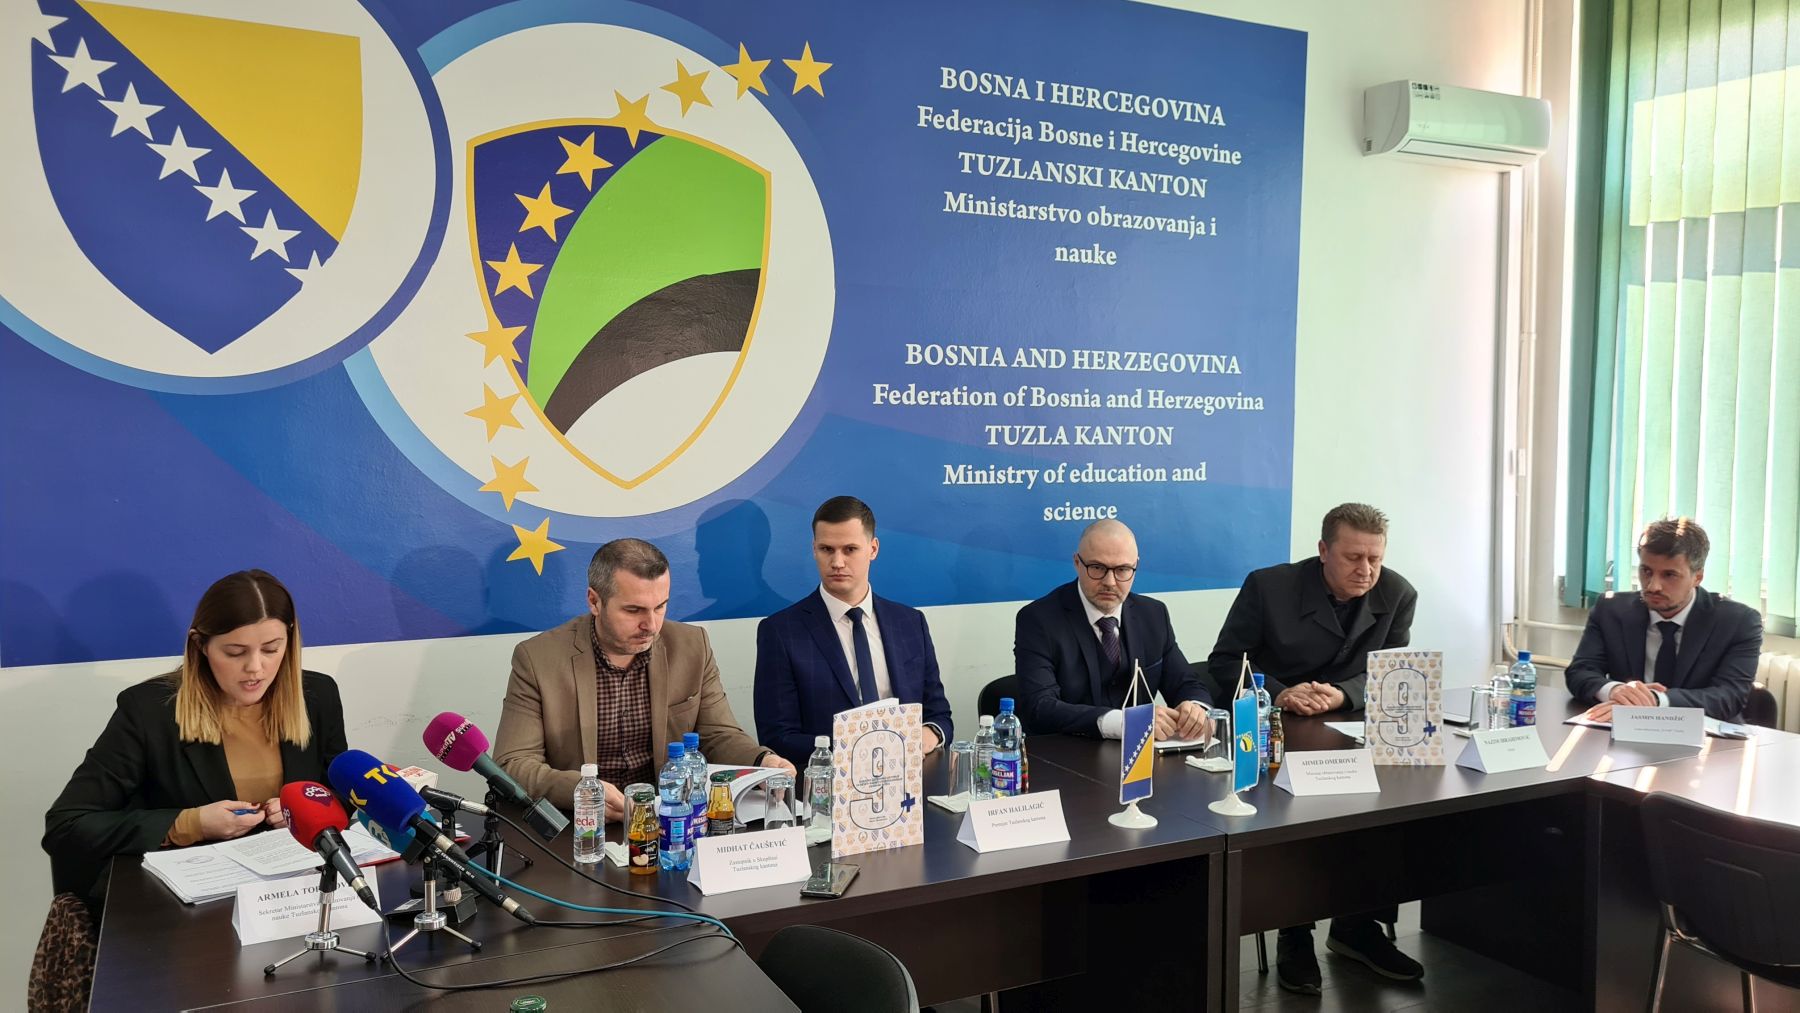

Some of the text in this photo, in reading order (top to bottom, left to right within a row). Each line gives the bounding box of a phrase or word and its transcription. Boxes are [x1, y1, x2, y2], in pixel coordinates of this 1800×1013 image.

[940, 66, 1226, 126] BOSNA I HERCEGOVINA
[917, 105, 1242, 166] Federacija Bosne i Hercegovine
[958, 151, 1208, 198] TUZLANSKI KANTON
[942, 191, 1217, 241] Ministarstvo obrazovanja i
[1054, 243, 1117, 266] nauke
[905, 343, 1242, 375] BOSNIA AND HERZEGOVINA
[872, 383, 1265, 416] Federation of Bosnia and Herzegovina
[984, 425, 1175, 446] TUZLA KANTON
[942, 461, 1208, 490] Ministry of education and
[1043, 501, 1118, 521] science
[988, 808, 1007, 817] IRFAN
[716, 838, 788, 854] MIDHAT ČAUŠEVIĆ
[257, 888, 300, 903] ARMELA
